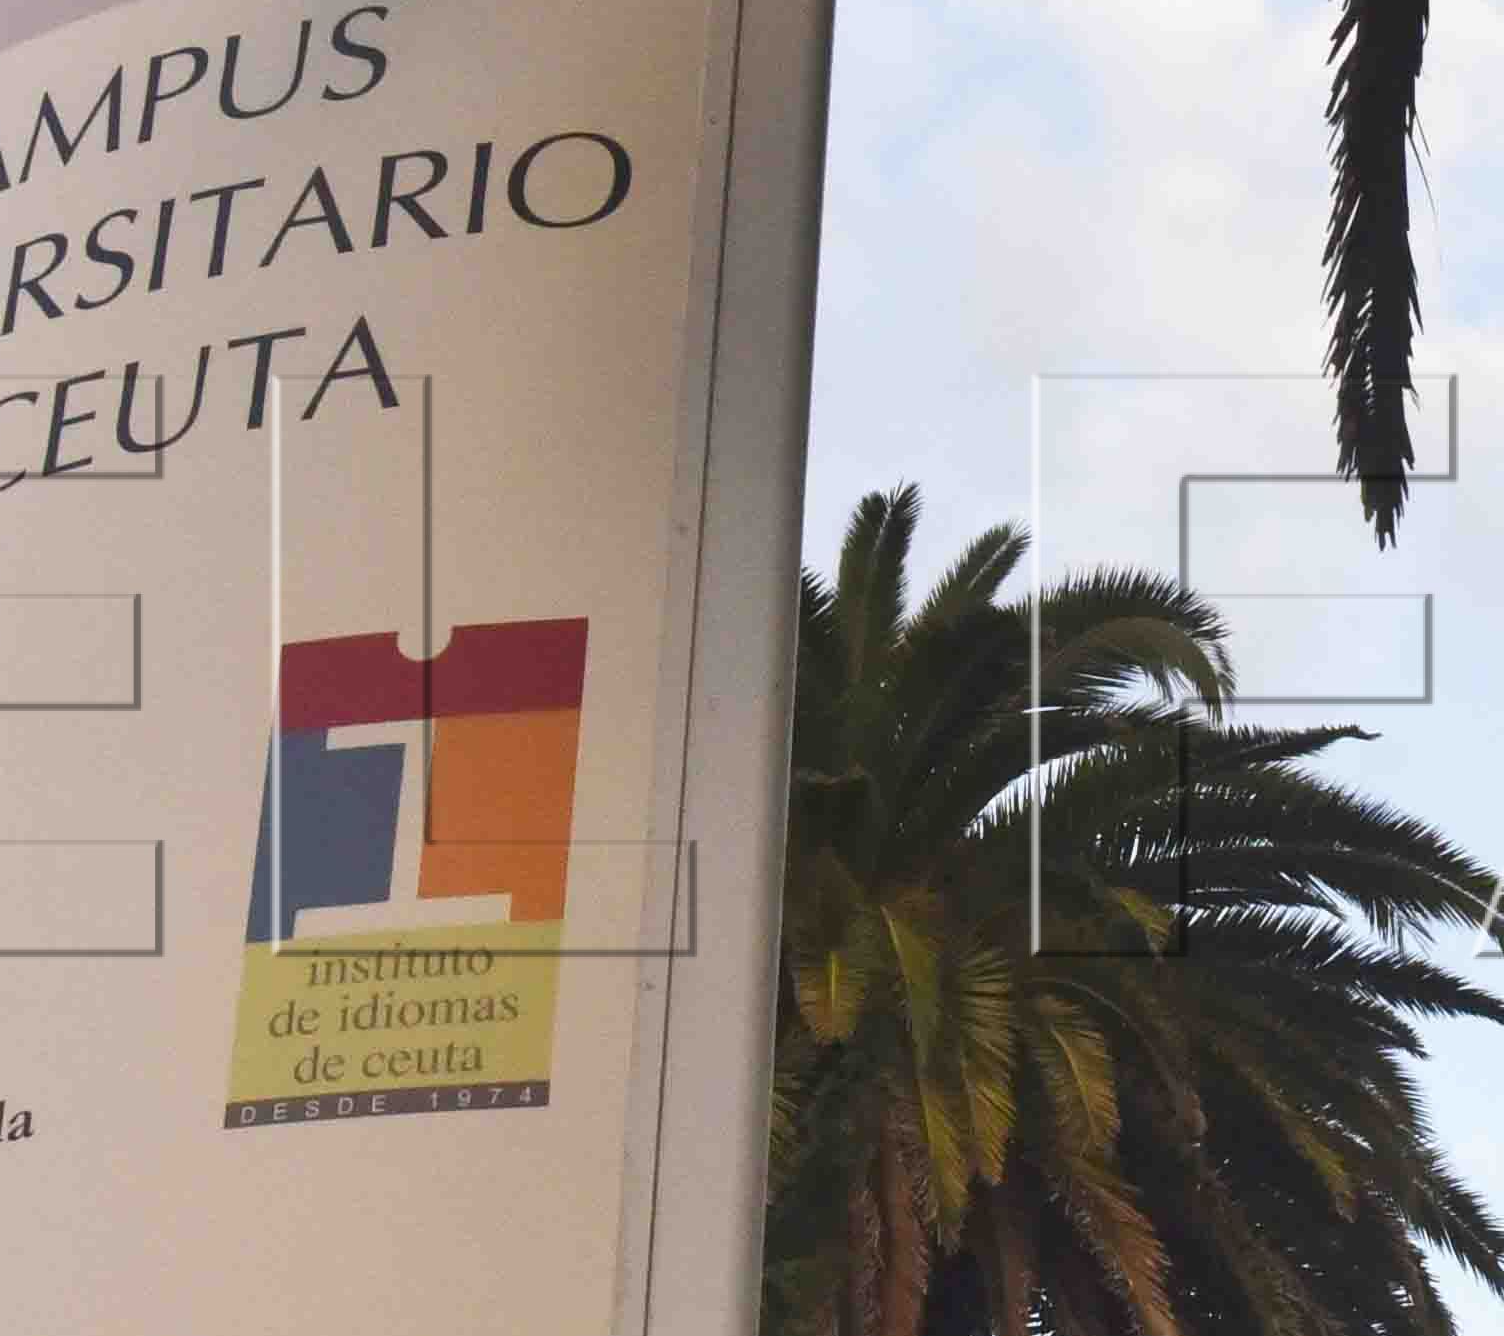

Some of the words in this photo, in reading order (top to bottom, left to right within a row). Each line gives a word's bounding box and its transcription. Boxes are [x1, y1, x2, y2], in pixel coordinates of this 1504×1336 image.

[309, 943, 495, 987] instituto
[269, 1000, 320, 1037] de
[340, 991, 520, 1032] idiomas
[294, 1046, 345, 1084] de
[362, 1041, 484, 1078] ceuta
[240, 1094, 388, 1124] DESDE
[429, 1087, 532, 1109] 1974
